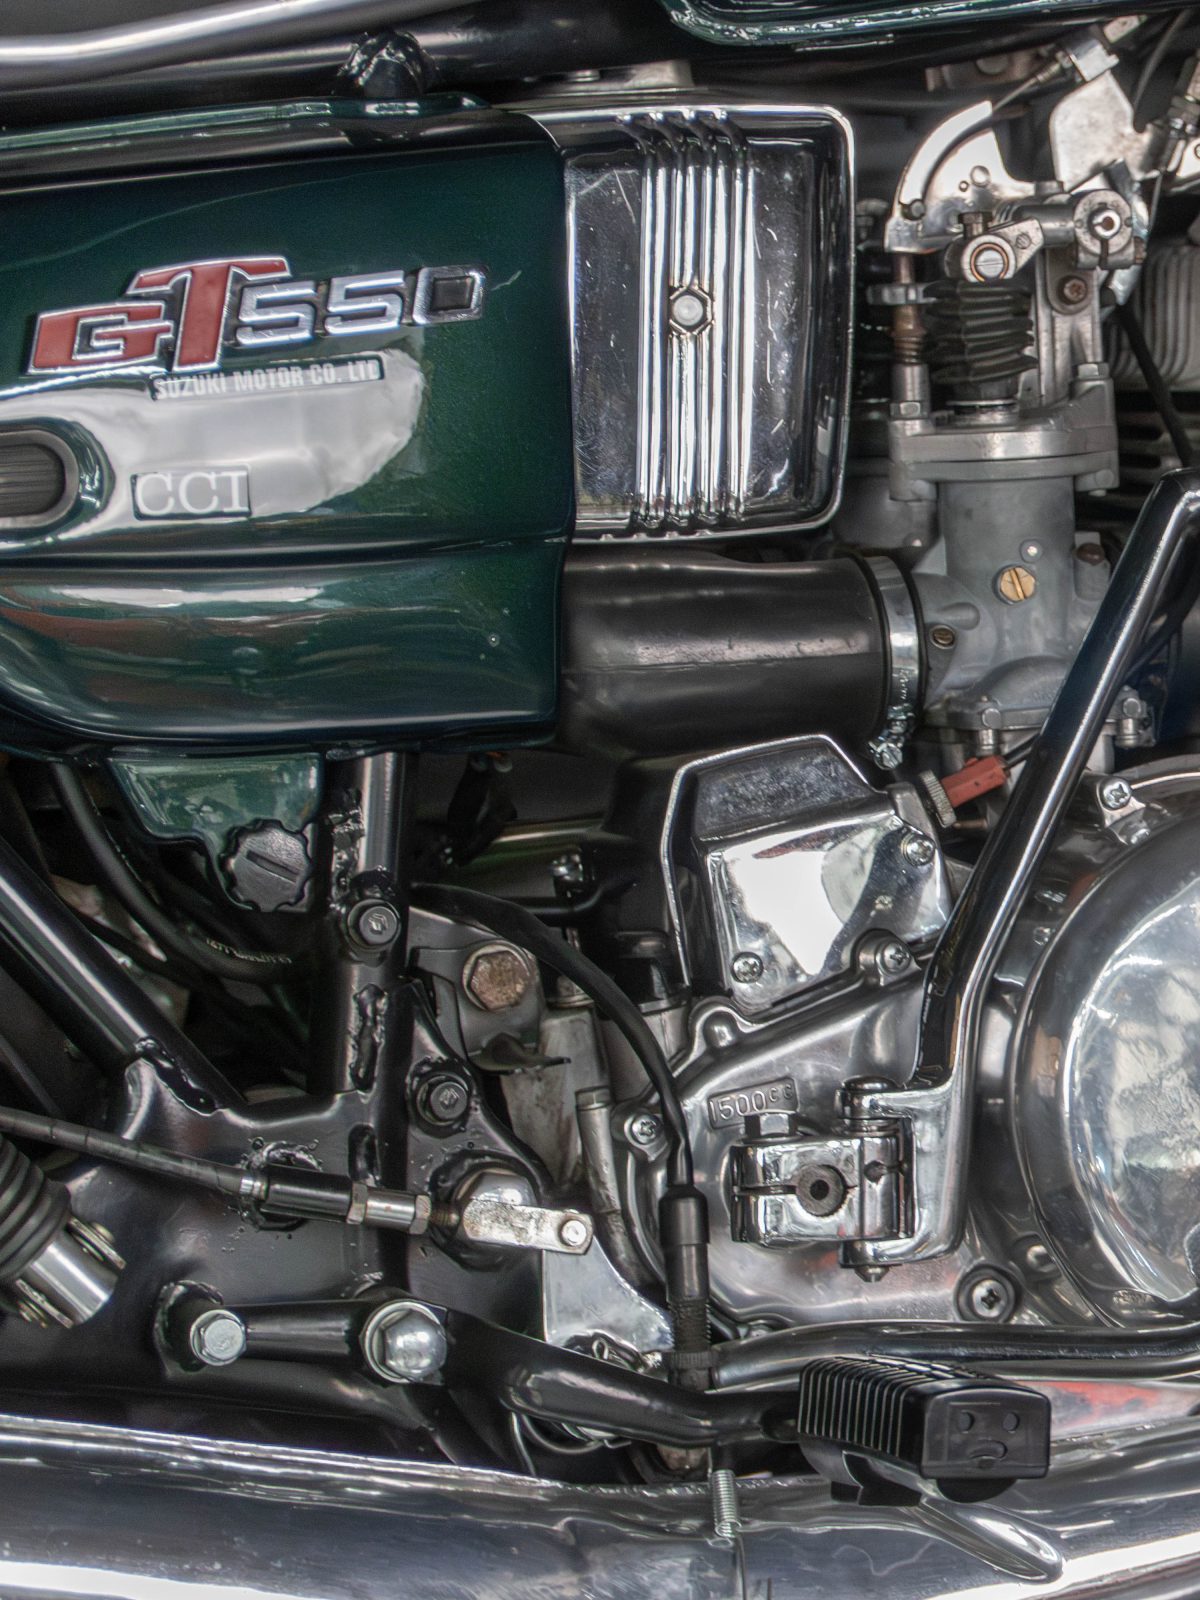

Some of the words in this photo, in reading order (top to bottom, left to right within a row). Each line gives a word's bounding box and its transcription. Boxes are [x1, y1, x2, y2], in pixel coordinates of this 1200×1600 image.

[154, 372, 227, 400] SUZUKI
[233, 366, 304, 392] MOTOR
[309, 362, 341, 386] CO.
[347, 358, 382, 382] LTD
[135, 470, 249, 515] CCI
